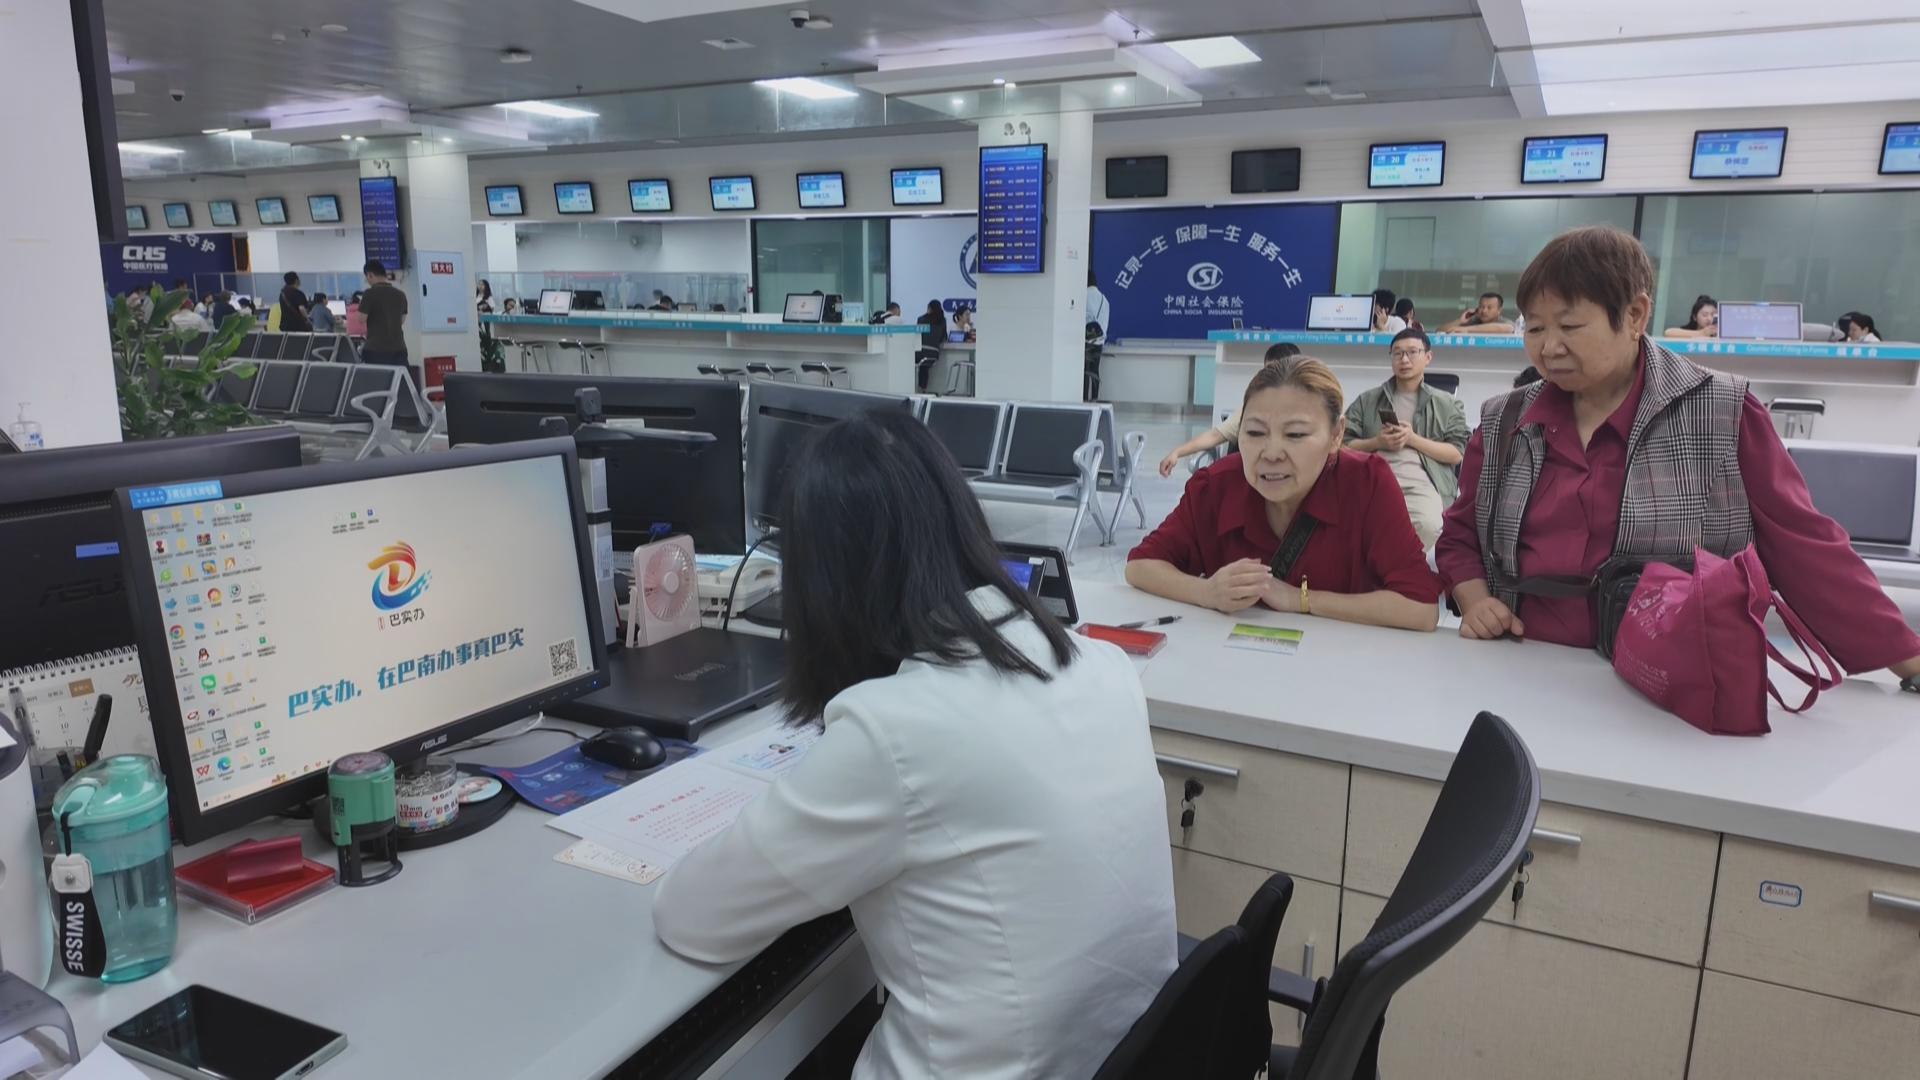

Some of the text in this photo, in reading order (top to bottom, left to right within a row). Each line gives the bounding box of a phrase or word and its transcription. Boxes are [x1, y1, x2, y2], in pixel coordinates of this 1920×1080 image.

[1391, 155, 1400, 164] 20
[1547, 149, 1556, 158] 21
[122, 245, 166, 261] CHS
[1115, 223, 1302, 289] 记录一生 保障一生 服务一生
[1164, 294, 1244, 308] 中国社会保险
[389, 608, 425, 627] 巴实办
[420, 734, 447, 752] ASUS
[65, 901, 85, 972] SWISSE
